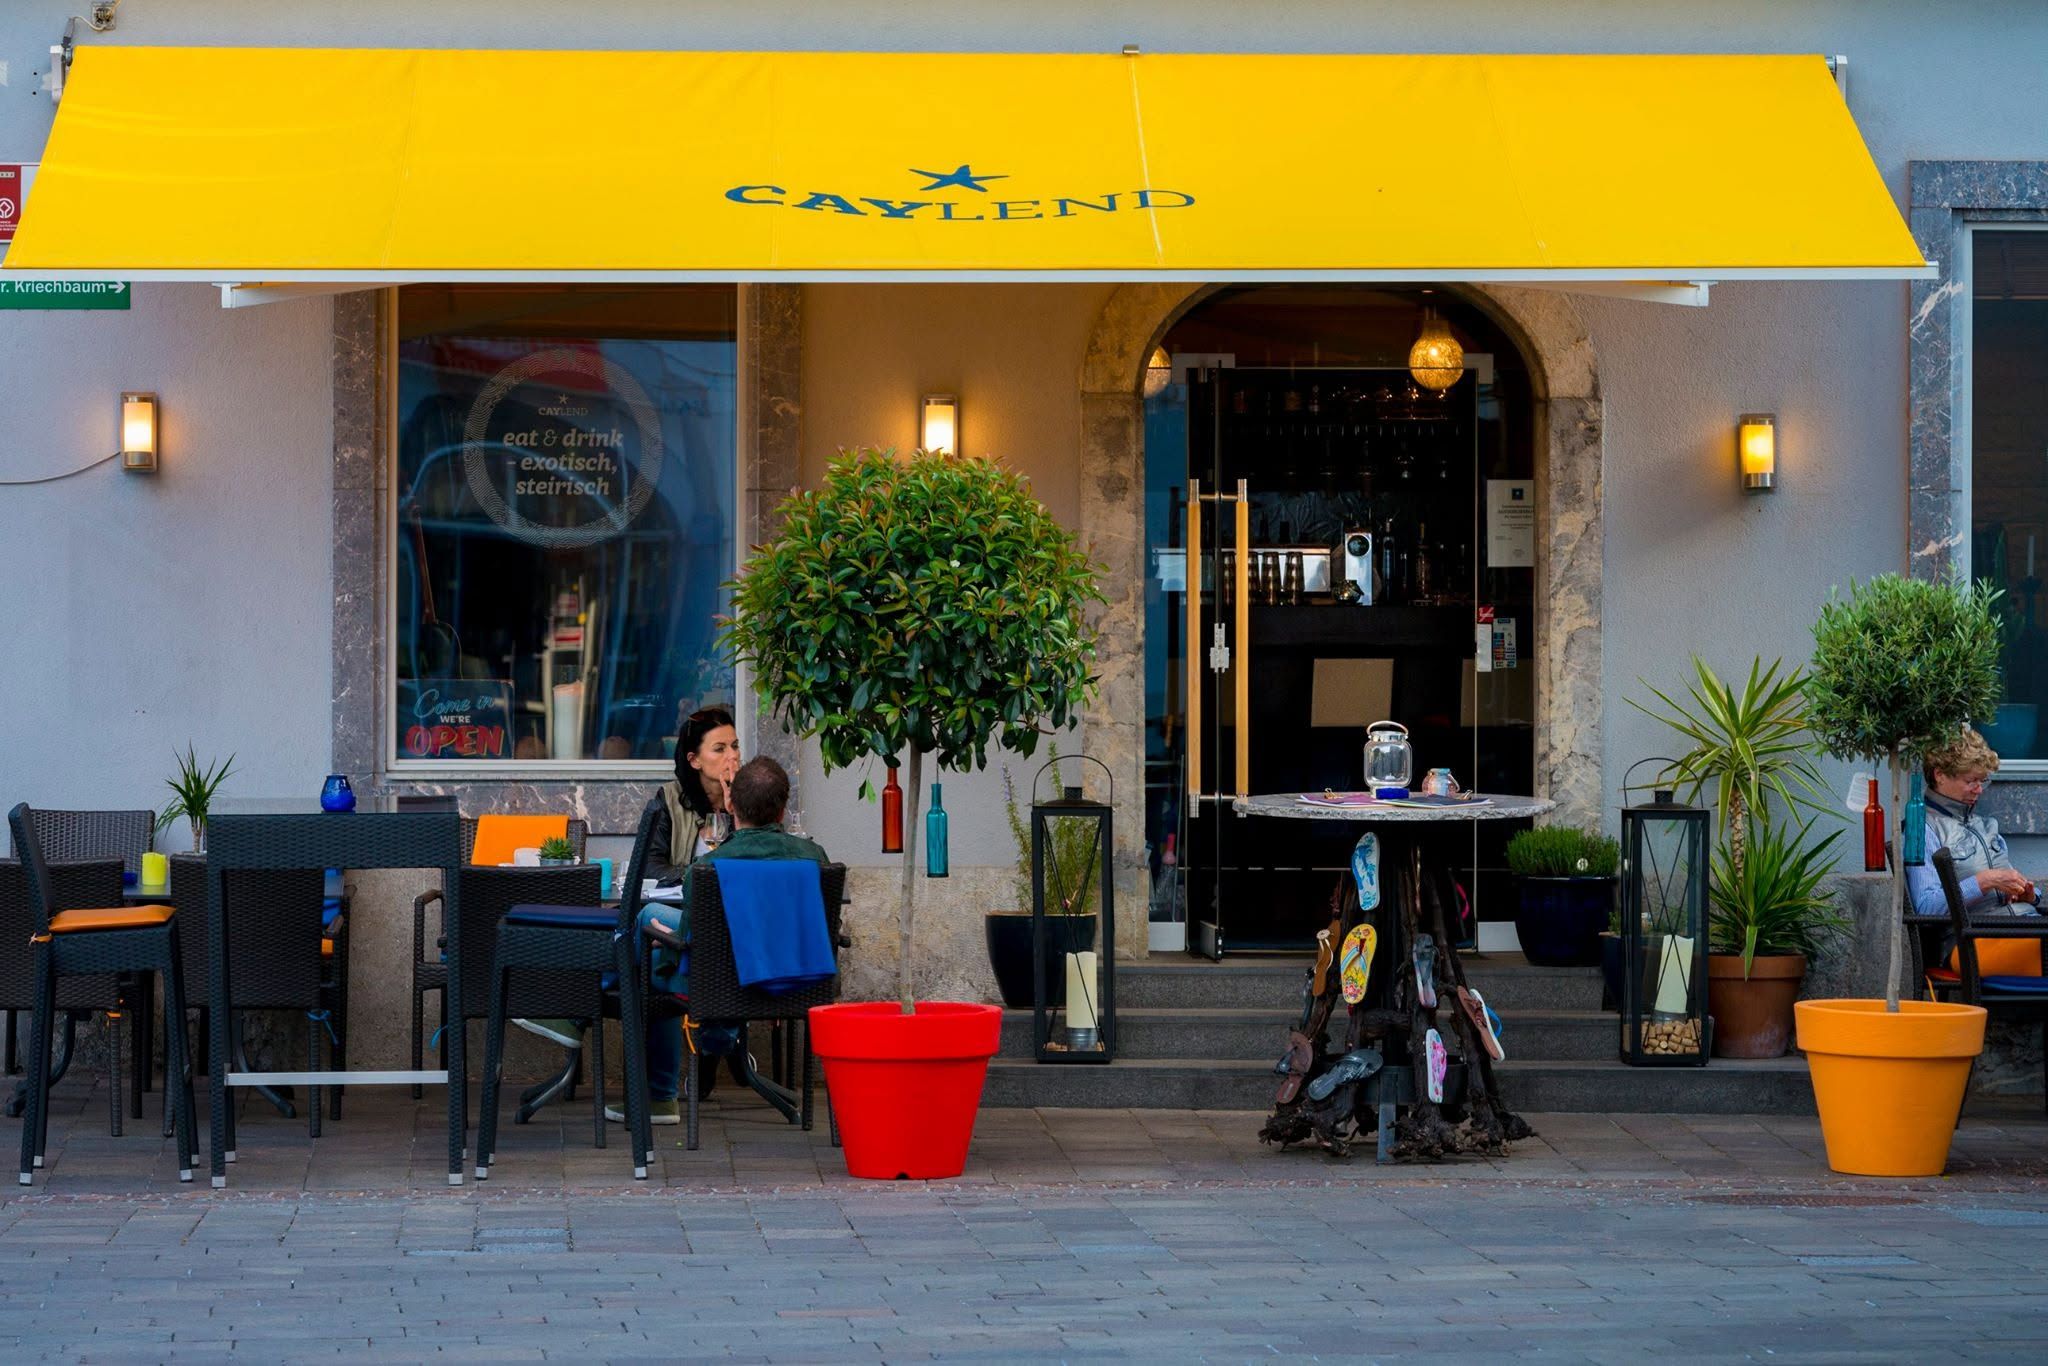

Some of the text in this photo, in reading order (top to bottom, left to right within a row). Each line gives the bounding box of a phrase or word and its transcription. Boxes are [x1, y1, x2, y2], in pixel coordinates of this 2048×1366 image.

[724, 184, 1196, 221] CAYLEND
[15, 281, 106, 293] Kriechbaum
[538, 407, 588, 416] CAYLEND
[503, 428, 623, 447] eat & drink
[520, 452, 618, 474] exotisch,
[516, 477, 609, 495] steirisch
[413, 689, 496, 718] Come in
[440, 715, 471, 724] WE'RE
[406, 725, 504, 756] OPEN
